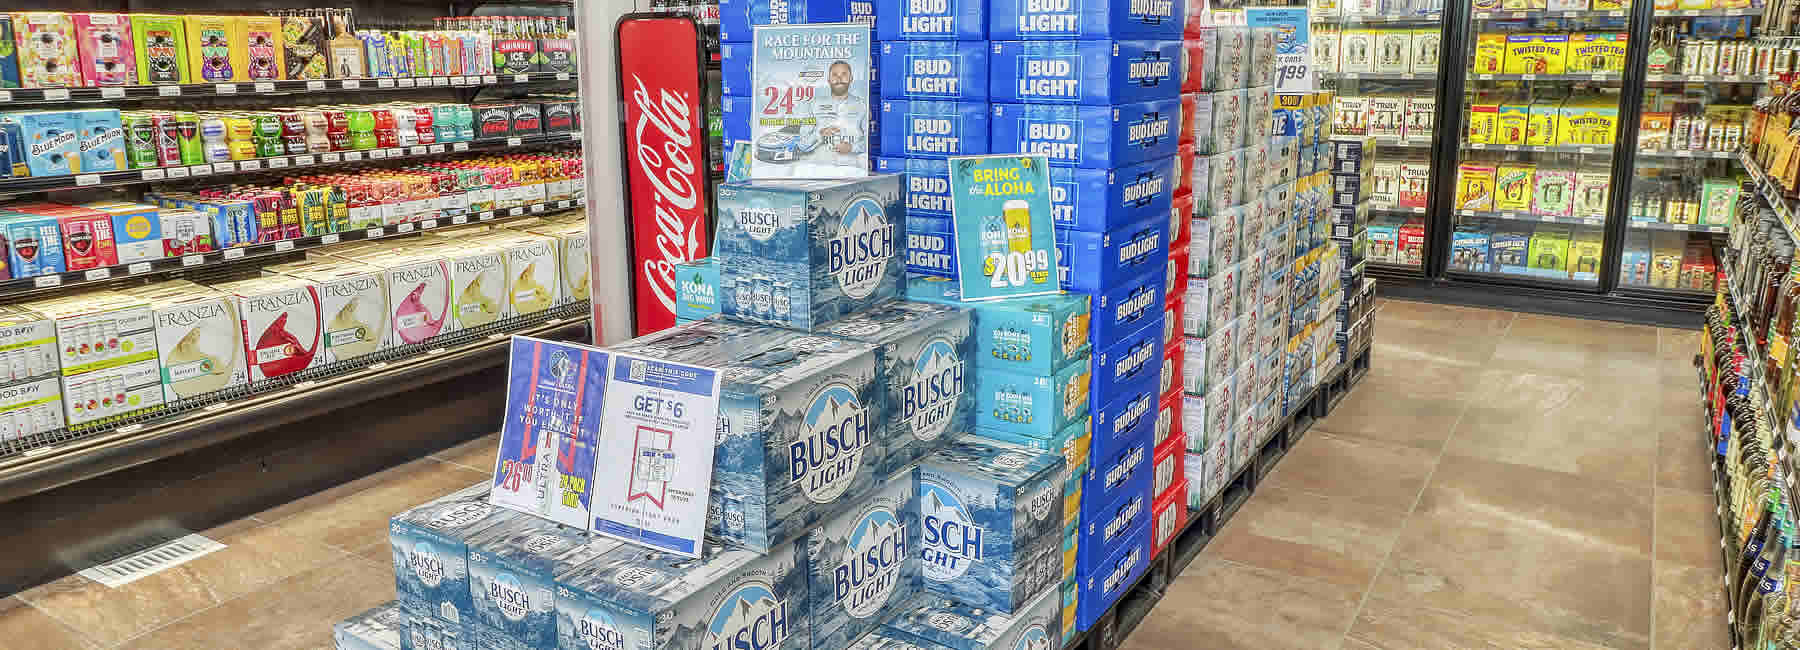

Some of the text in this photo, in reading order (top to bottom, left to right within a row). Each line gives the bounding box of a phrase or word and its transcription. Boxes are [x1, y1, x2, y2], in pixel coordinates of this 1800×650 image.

[903, 16, 953, 33] LIGHT
[1019, 15, 1077, 32] LIGHT
[764, 32, 861, 48] RACE FOR THE
[772, 47, 853, 60] MOUNTAINS
[1512, 45, 1546, 56] TWISTED
[1546, 46, 1560, 56] TEA
[1575, 44, 1625, 56] TWISTED TEA
[914, 59, 952, 76] BUD
[1028, 60, 1070, 77] BUD
[1129, 61, 1171, 78] BUD LIGHT
[906, 77, 958, 94] LIGHT
[1019, 80, 1078, 96] LIGHT
[914, 119, 952, 134] BUD
[1129, 119, 1170, 141] BUD LIGHT
[1568, 117, 1599, 127] TWISTED
[79, 128, 123, 151] BLUE MOON
[1029, 124, 1071, 141] BUD
[31, 132, 76, 156] BLUE MOON
[907, 136, 959, 153] LIGHT
[1020, 143, 1079, 160] LIGHT
[973, 167, 1020, 183] BRING
[635, 72, 699, 315] Coca-Cola
[910, 177, 948, 193] BUD
[984, 181, 1035, 196] ALOHA
[1124, 176, 1163, 203] BUD LIGHT
[905, 192, 953, 211] LIGHT
[740, 211, 779, 228] BUSCH
[749, 225, 773, 235] LIGHT
[829, 224, 894, 274] BUSCH
[908, 234, 944, 251] BUD
[1120, 234, 1160, 262] BUD LIGHT
[511, 243, 553, 262] FRANZIA
[456, 255, 501, 273] FRANZIA
[844, 261, 882, 286] LIGHT
[392, 264, 442, 284] FRANZIA
[324, 278, 379, 298] FRANZIA
[682, 279, 715, 297] KONA
[249, 289, 311, 313] FRANZIA
[1116, 288, 1156, 321] BUD LIGHT
[159, 303, 227, 328] FRANZIA
[1116, 343, 1155, 377] BUD LIGHT
[903, 361, 964, 422] BUSCH
[553, 399, 578, 410] ONLY
[634, 396, 665, 413] GET
[520, 415, 538, 426] YOU
[917, 400, 953, 431] LIGHT
[1114, 397, 1151, 433] BUD LIGHT
[790, 407, 871, 483] BUSCH
[809, 454, 856, 493] LIGHT
[1105, 448, 1144, 489] BUD LIGHT
[1105, 497, 1142, 540] BUD LIGHT
[923, 515, 985, 561] SCH
[410, 551, 445, 574] BUSCH
[833, 524, 909, 602] BUSCH
[922, 547, 962, 570] GHT
[418, 569, 440, 582] LIGHT
[1104, 547, 1140, 595] BUD LIGHT
[490, 582, 530, 610] BUSCH
[852, 566, 896, 609] LIGHT
[499, 602, 528, 616] LIGHT
[580, 619, 625, 650] BUSCH
